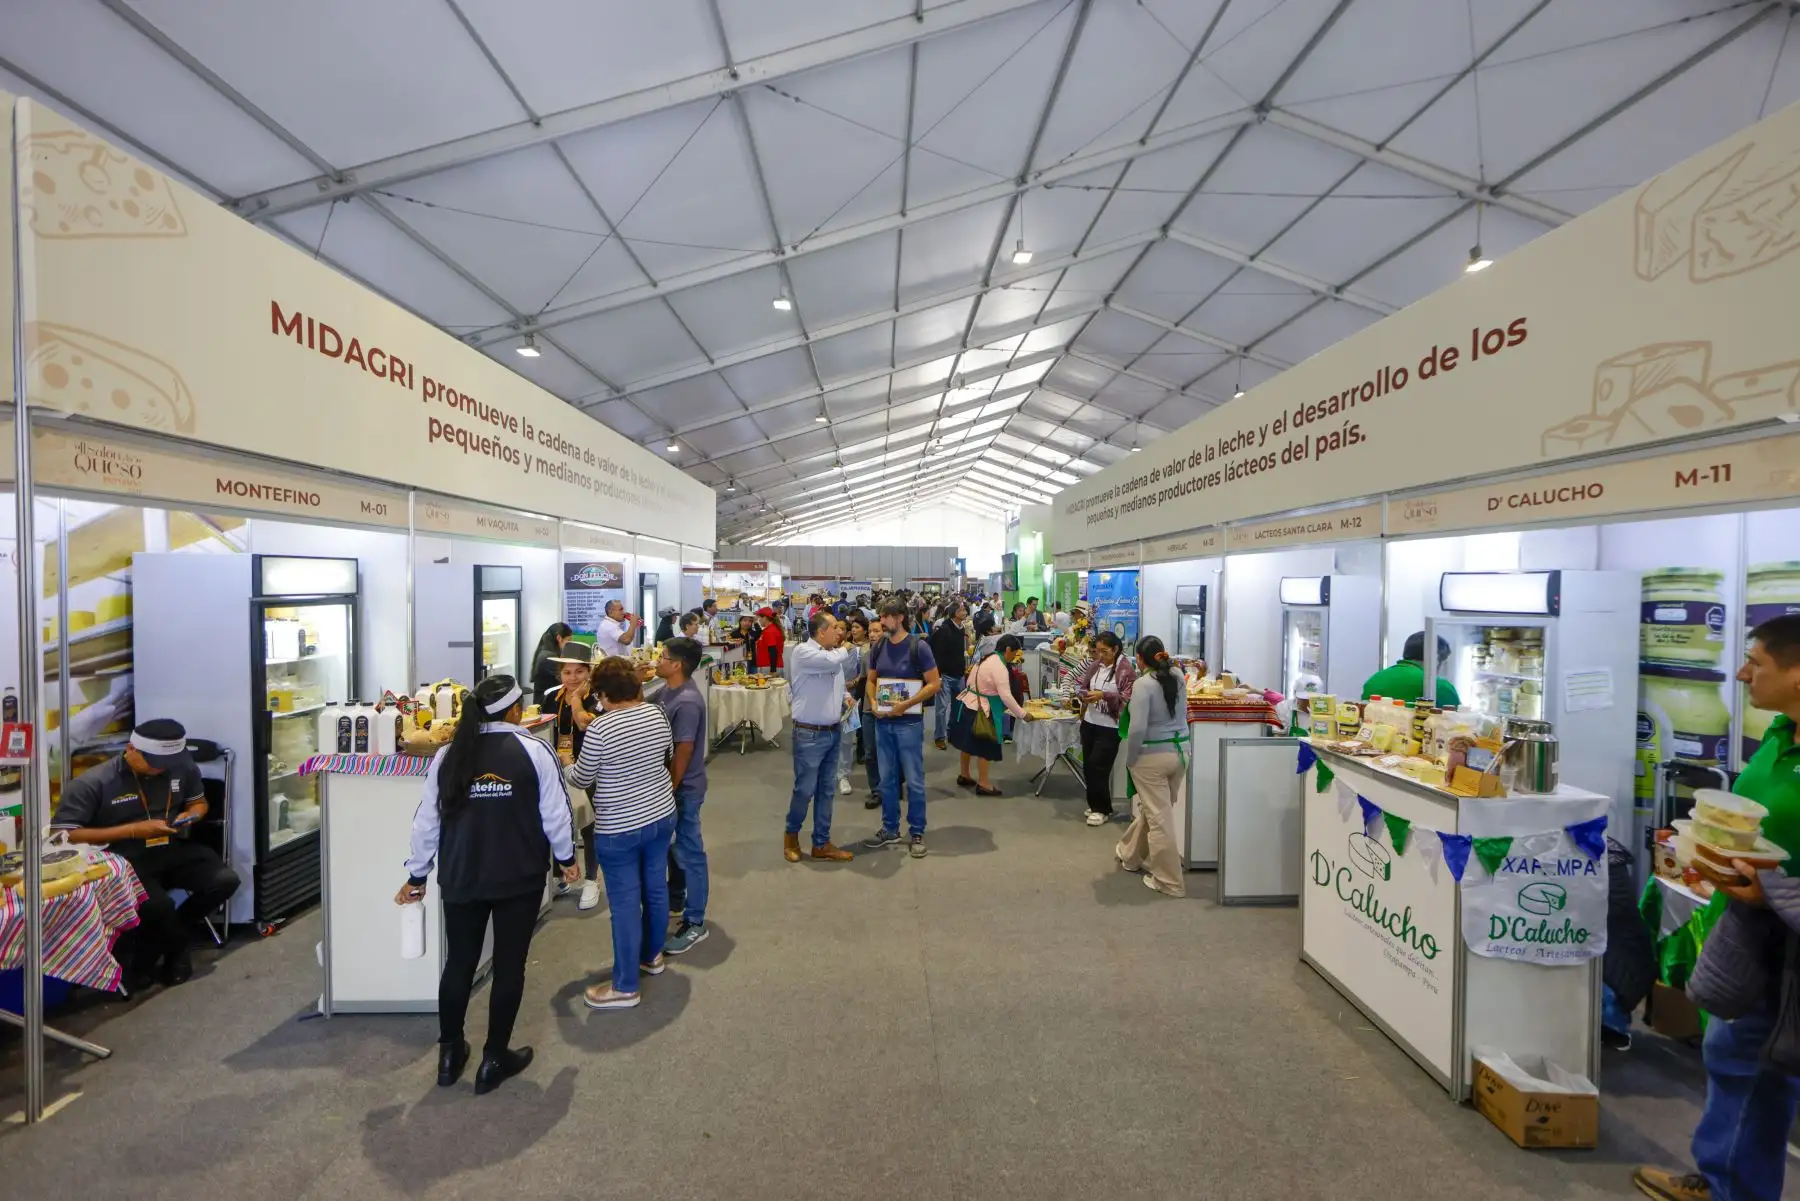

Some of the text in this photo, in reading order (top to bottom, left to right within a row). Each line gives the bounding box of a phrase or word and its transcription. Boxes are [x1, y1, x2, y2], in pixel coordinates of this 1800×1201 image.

[271, 299, 414, 390] MIDAGRI
[422, 375, 518, 433] promueve
[522, 416, 534, 441] la
[538, 429, 580, 461] cadena
[583, 447, 595, 466] de
[597, 456, 618, 476] valor
[1085, 489, 1113, 511] promueve
[1115, 483, 1121, 497] la
[1121, 475, 1148, 495] cadena
[1150, 467, 1160, 484] de
[1162, 458, 1186, 479] valor
[1188, 449, 1201, 468] de
[1204, 444, 1214, 466] la
[1218, 430, 1255, 457] leche
[1259, 423, 1268, 447] y
[1272, 410, 1287, 436] el
[1292, 365, 1409, 429] desarrollo
[1418, 345, 1460, 380] de
[1471, 317, 1528, 362] los
[428, 416, 520, 465] pequeños
[524, 452, 532, 474] y
[536, 457, 592, 490] medianos
[1086, 420, 1366, 529] pequeños y medianos productores lácteos del país.
[1674, 463, 1732, 488] M-11
[216, 478, 387, 517] MONTEFINO M-01
[1487, 483, 1604, 511] D' CALUCHO
[476, 517, 519, 532] MI VAQUITA
[1282, 525, 1305, 536] SANTA
[1307, 521, 1333, 534] CLARA
[1340, 516, 1362, 530] M-12
[471, 781, 512, 792] ntefino
[1310, 848, 1442, 960] D'Calucho
[1488, 914, 1591, 944] D'Calucho
[1525, 1096, 1562, 1113] Dove
